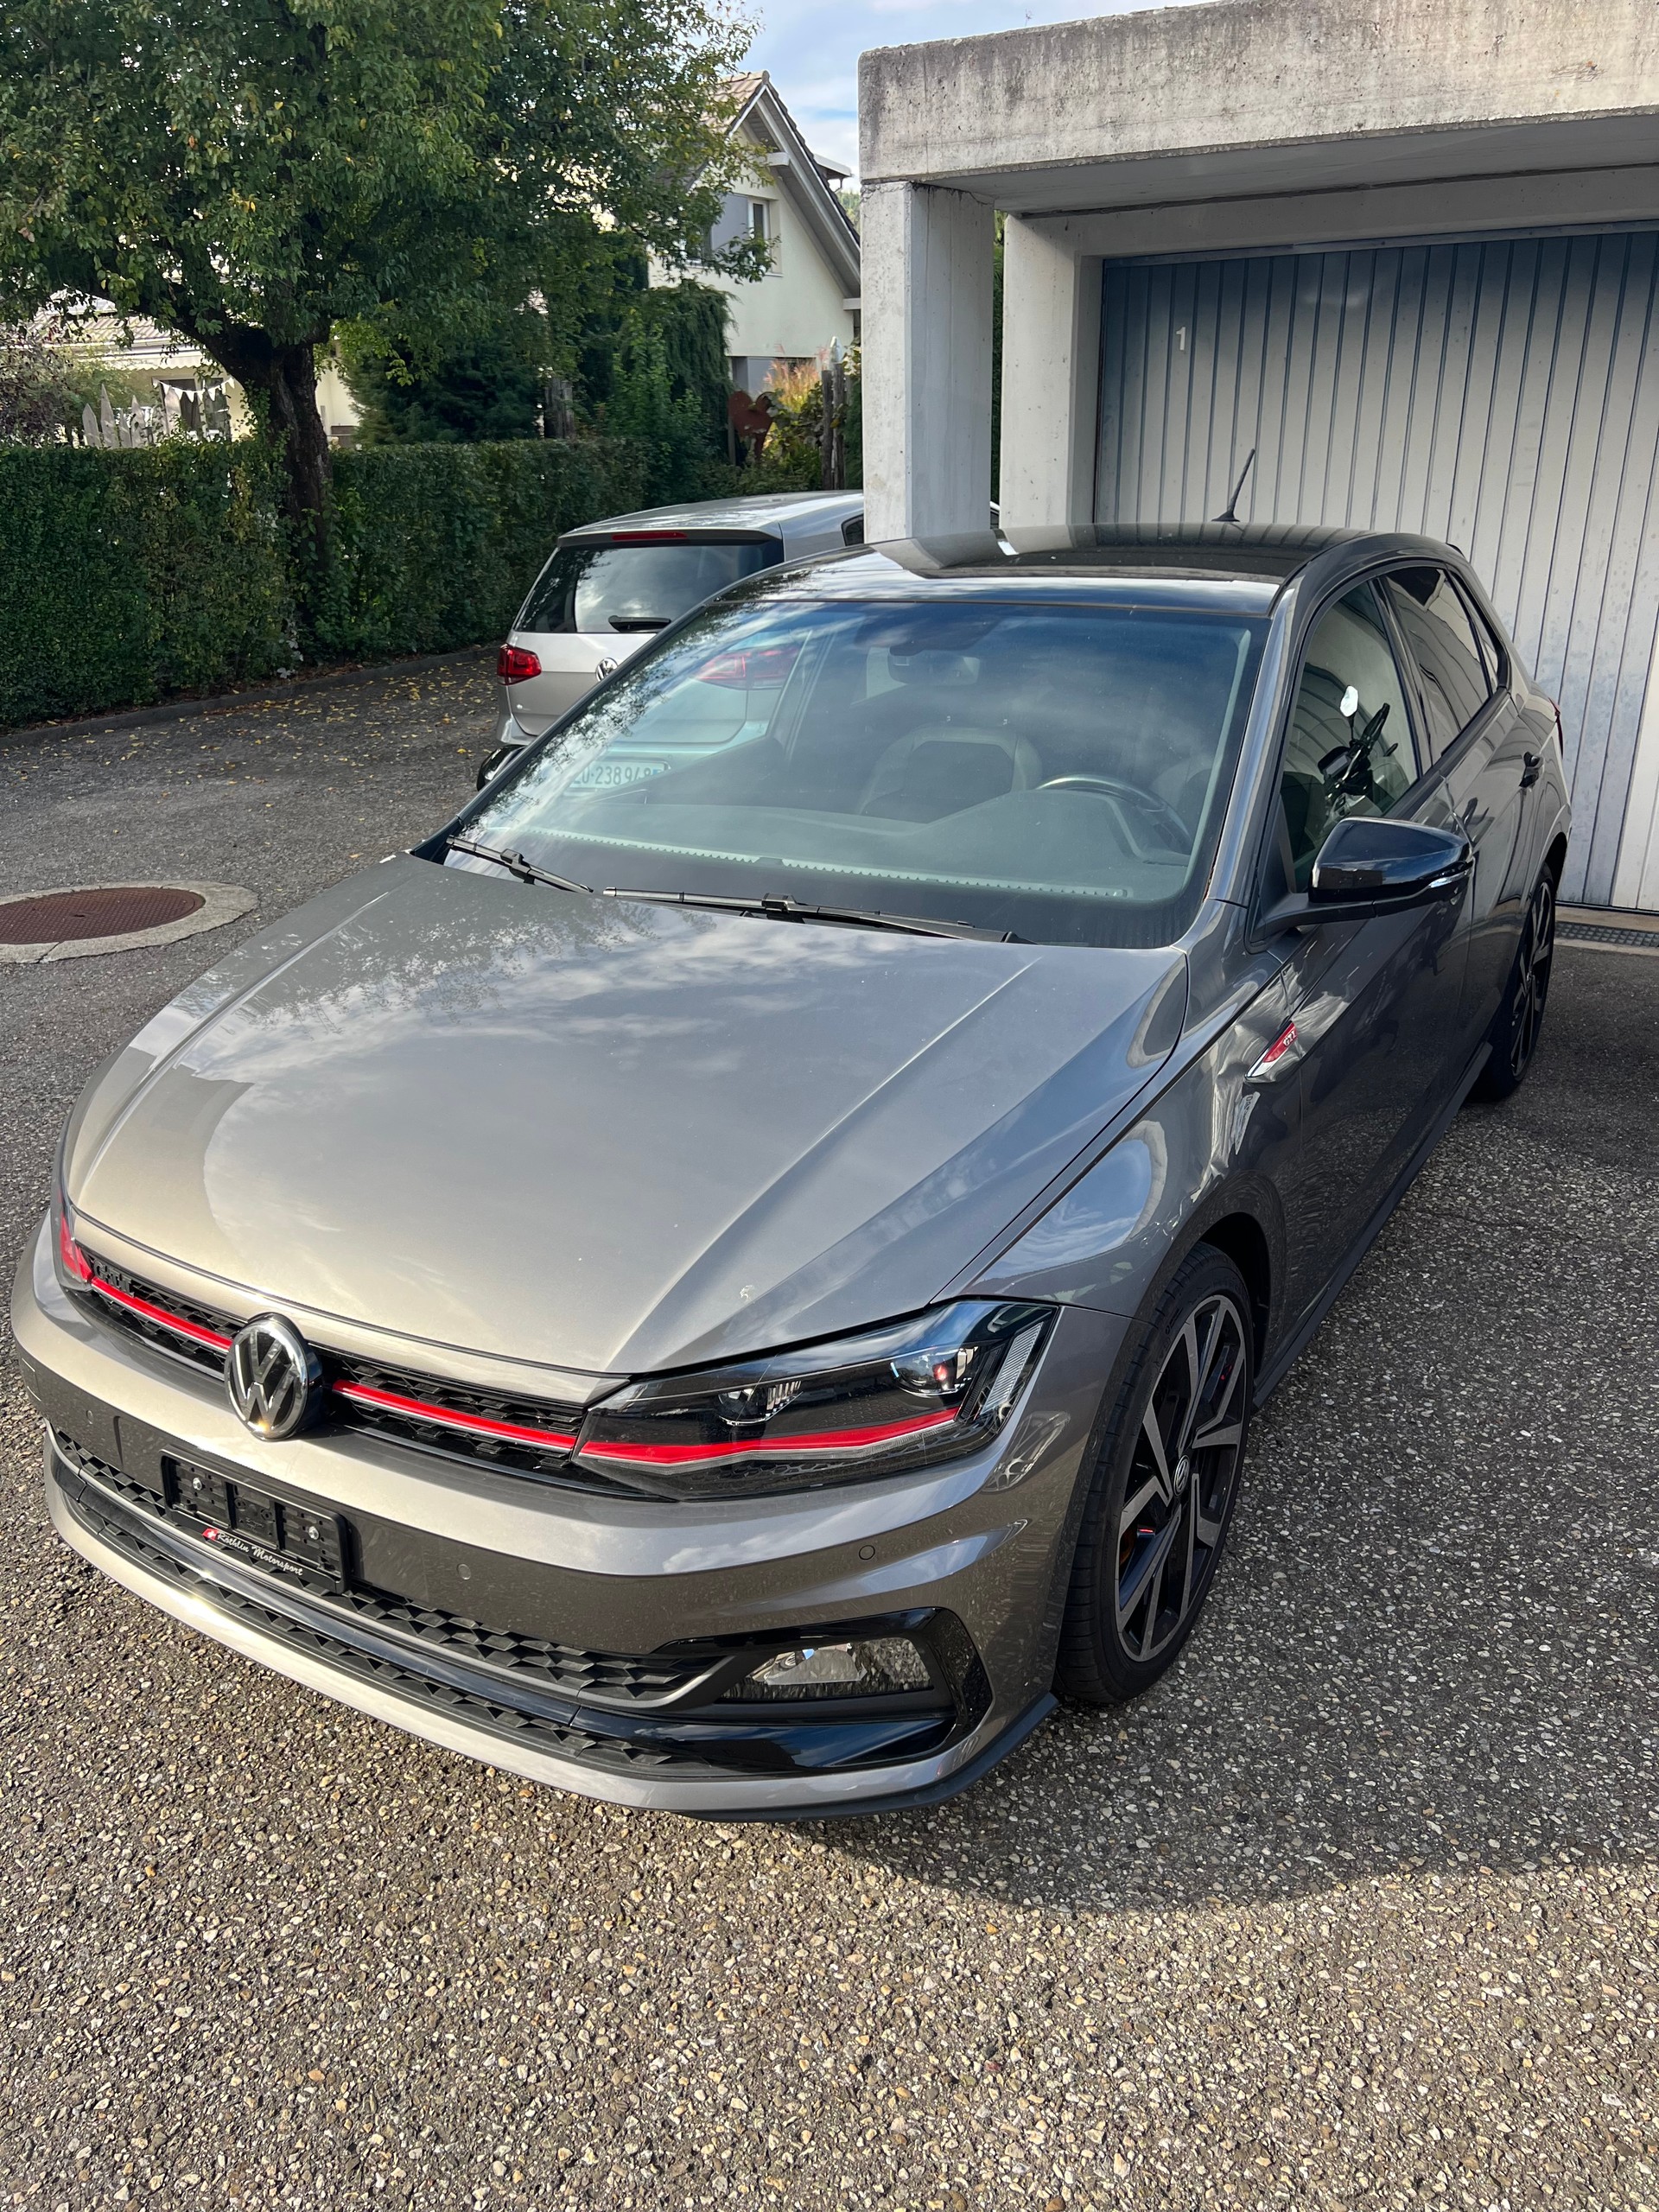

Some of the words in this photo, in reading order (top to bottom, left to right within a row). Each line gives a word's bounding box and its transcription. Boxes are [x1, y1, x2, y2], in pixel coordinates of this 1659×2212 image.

[1176, 327, 1185, 351] 1
[1282, 1030, 1297, 1047] GTI
[94, 1261, 134, 1297] GTI
[226, 1322, 306, 1440] VW
[251, 1543, 303, 1575] Motorsport
